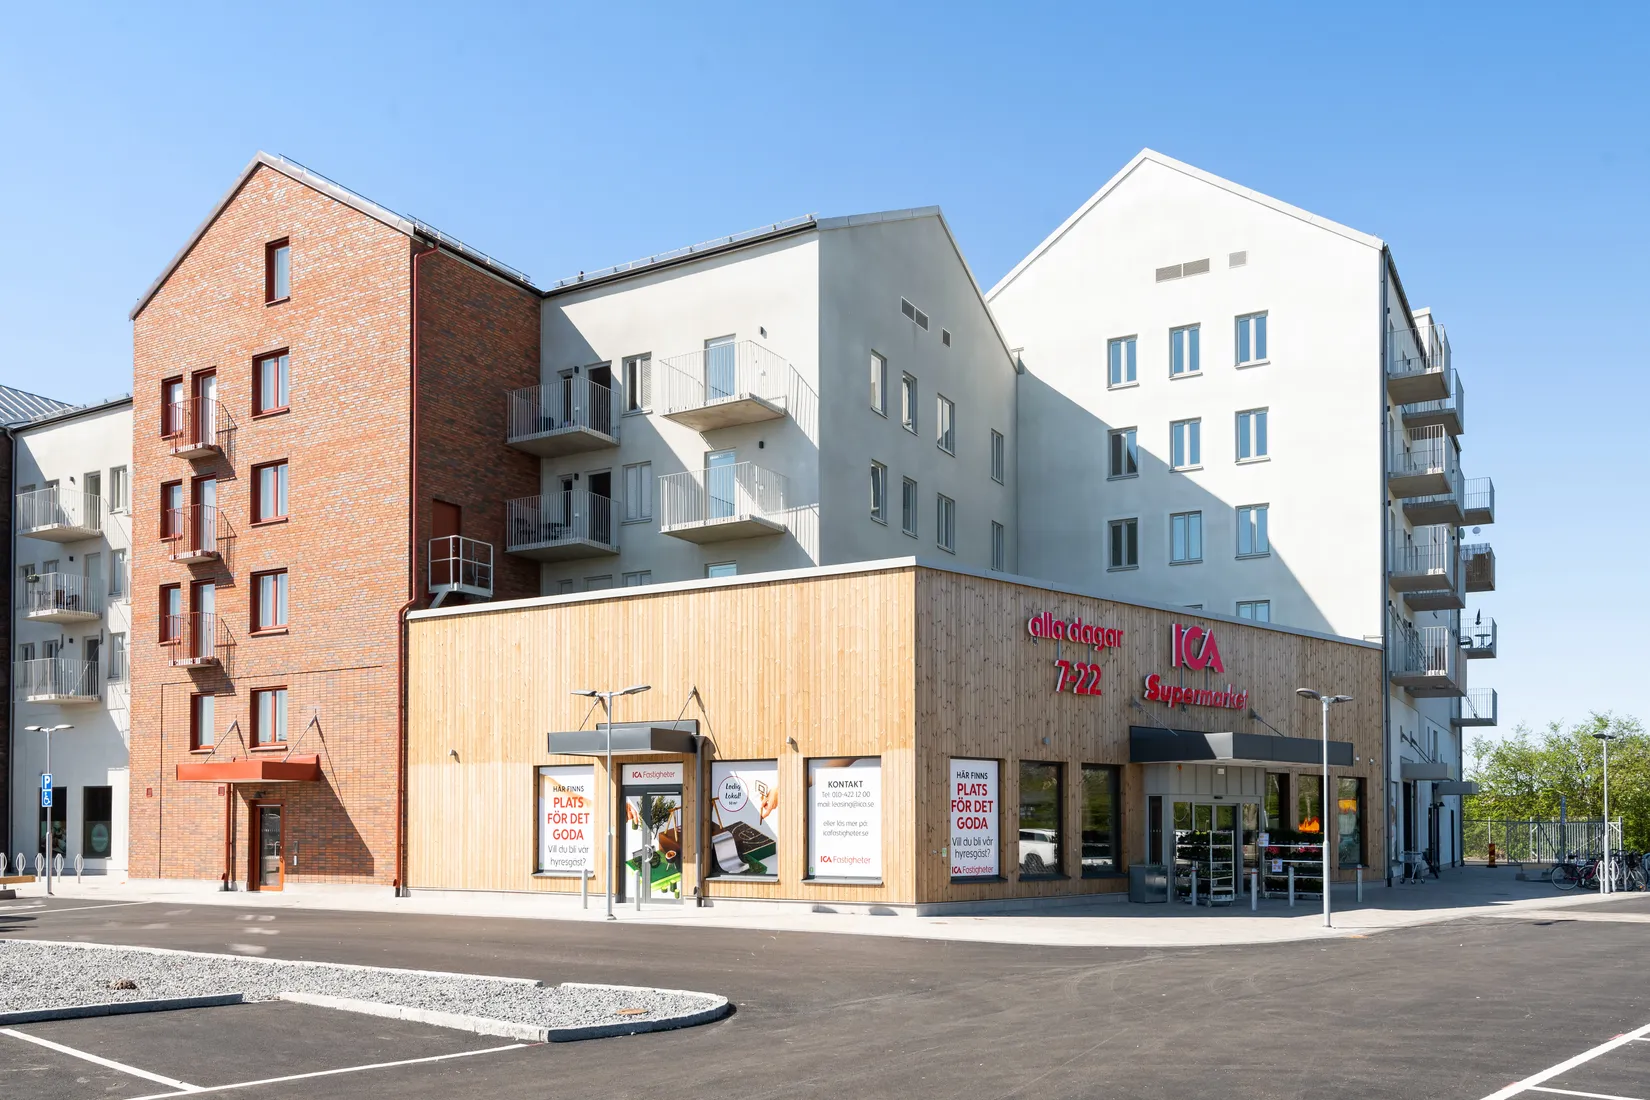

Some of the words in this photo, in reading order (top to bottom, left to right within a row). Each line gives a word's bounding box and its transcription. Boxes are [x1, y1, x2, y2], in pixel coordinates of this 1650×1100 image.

[1027, 611, 1065, 640] alla
[1067, 617, 1124, 651] dagar
[1171, 623, 1225, 673] ICA
[1054, 659, 1102, 696] 7-22
[1144, 673, 1249, 710] Supermarket
[632, 771, 643, 779] ICA
[643, 770, 676, 780] Fastigheter
[956, 770, 970, 779] HÄR
[970, 771, 988, 780] FINNS
[44, 775, 51, 789] P
[553, 784, 566, 792] HÄR
[827, 780, 864, 788] KONTAKT
[957, 782, 988, 796] PLATS
[553, 796, 584, 808] PLATS
[951, 797, 972, 813] FÖR
[974, 800, 993, 813] DET
[547, 810, 568, 824] FÖR
[570, 812, 590, 824] DET
[956, 816, 989, 829] GODA
[552, 828, 584, 841] GODA
[951, 837, 962, 846] Vill
[963, 837, 972, 847] du
[973, 837, 982, 846] bli
[982, 836, 994, 846] vår
[547, 844, 557, 853] Vill
[558, 844, 568, 853] du
[568, 844, 577, 853] bli
[954, 848, 991, 860] hyresgäst?
[550, 857, 587, 868] hyresgäst?
[820, 855, 832, 863] ICA
[832, 855, 872, 866] Fastigheter
[951, 866, 962, 874] ICA
[962, 865, 994, 875] Fastigheter
